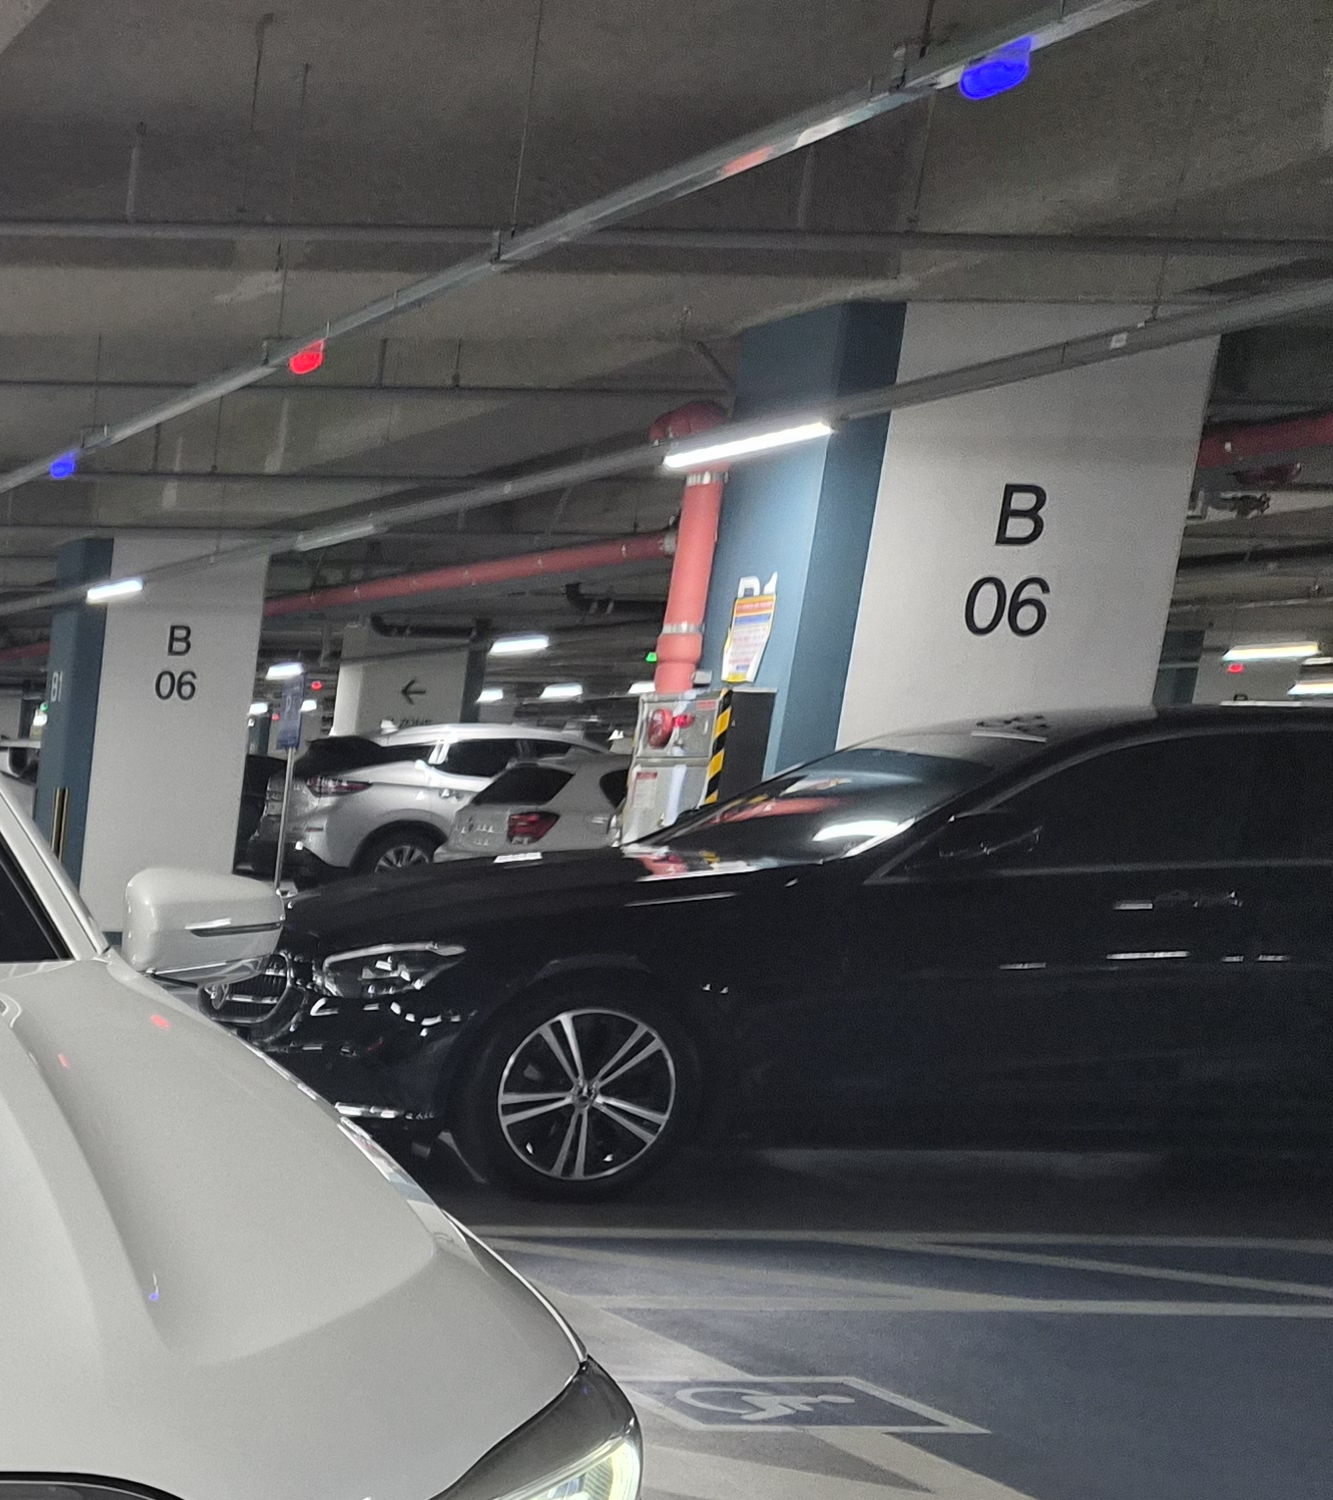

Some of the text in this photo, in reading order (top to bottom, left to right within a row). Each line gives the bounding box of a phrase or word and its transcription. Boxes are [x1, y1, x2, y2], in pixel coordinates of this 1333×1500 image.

[995, 482, 1047, 546] B
[964, 576, 1051, 637] 06
[167, 625, 192, 656] B
[155, 671, 197, 701] 06
